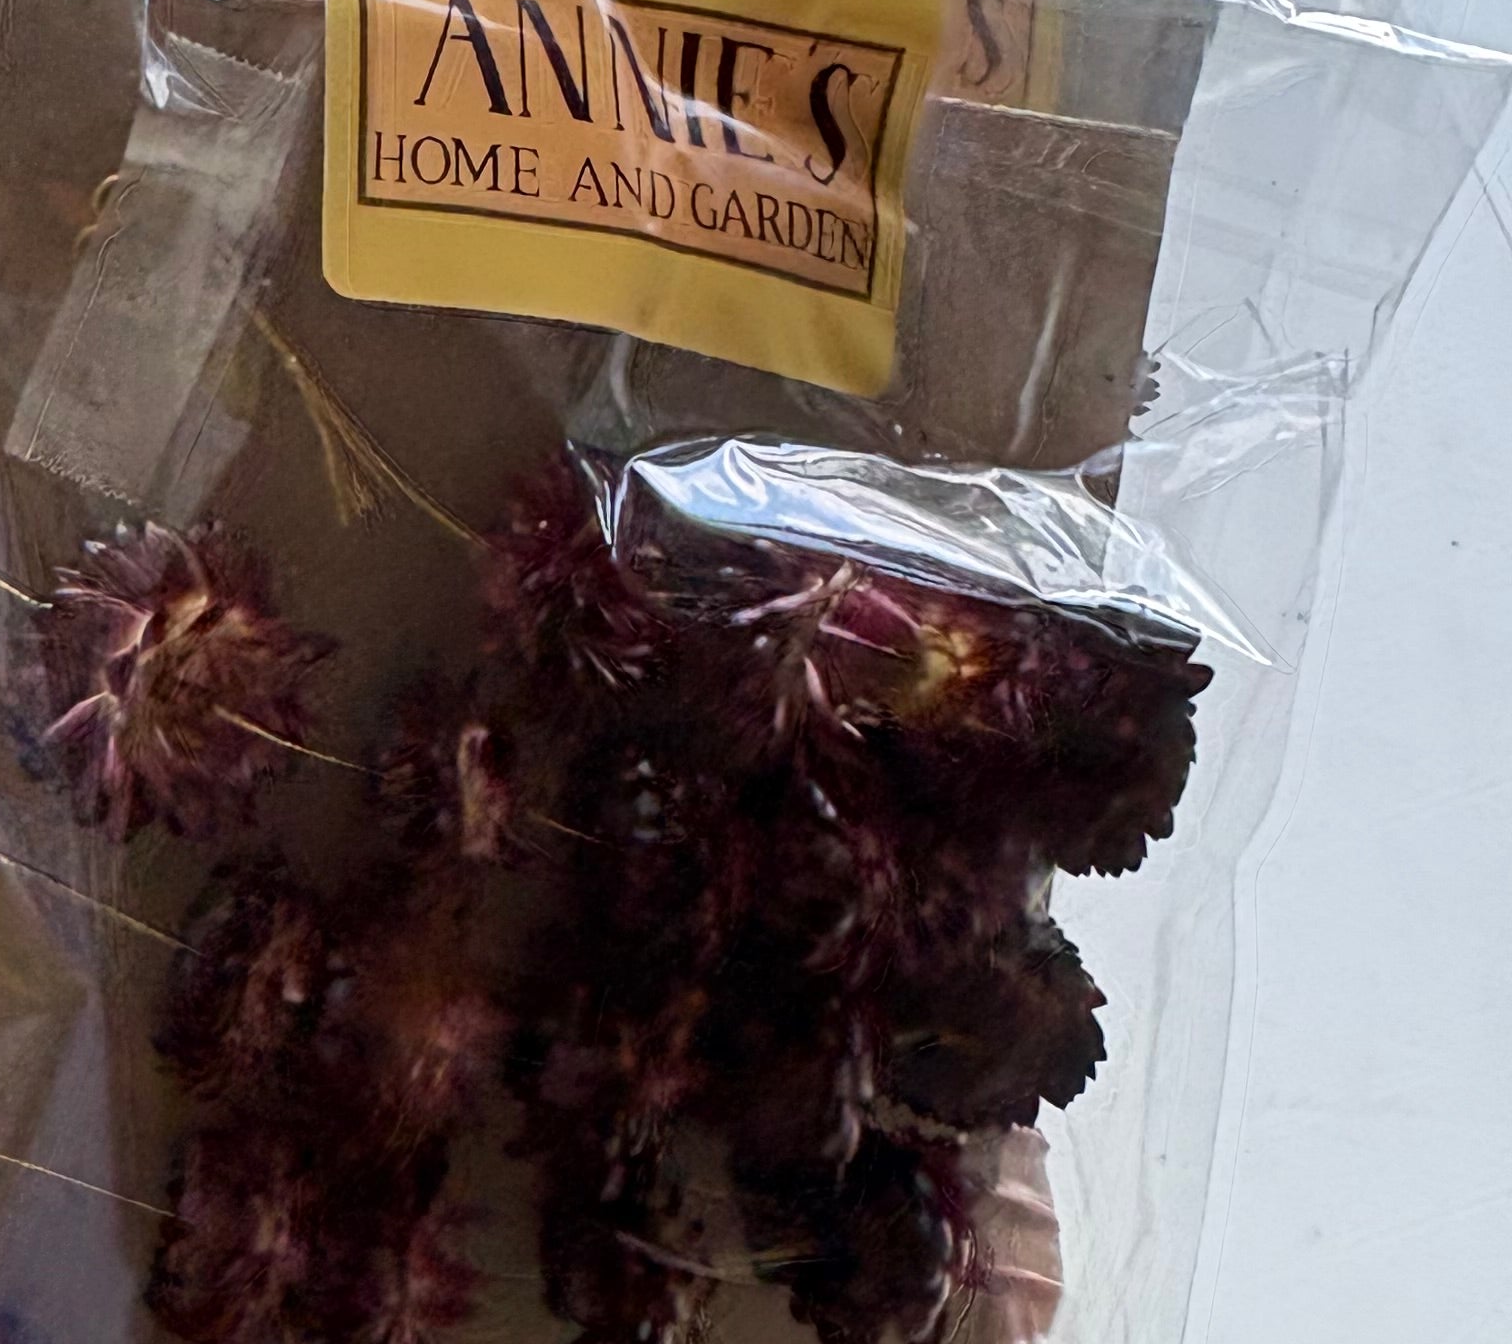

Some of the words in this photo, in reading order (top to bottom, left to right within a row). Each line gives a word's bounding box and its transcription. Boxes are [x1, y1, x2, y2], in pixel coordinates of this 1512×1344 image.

[373, 130, 540, 197] HOME
[569, 156, 676, 220] AND
[691, 182, 869, 270] GARDEN
